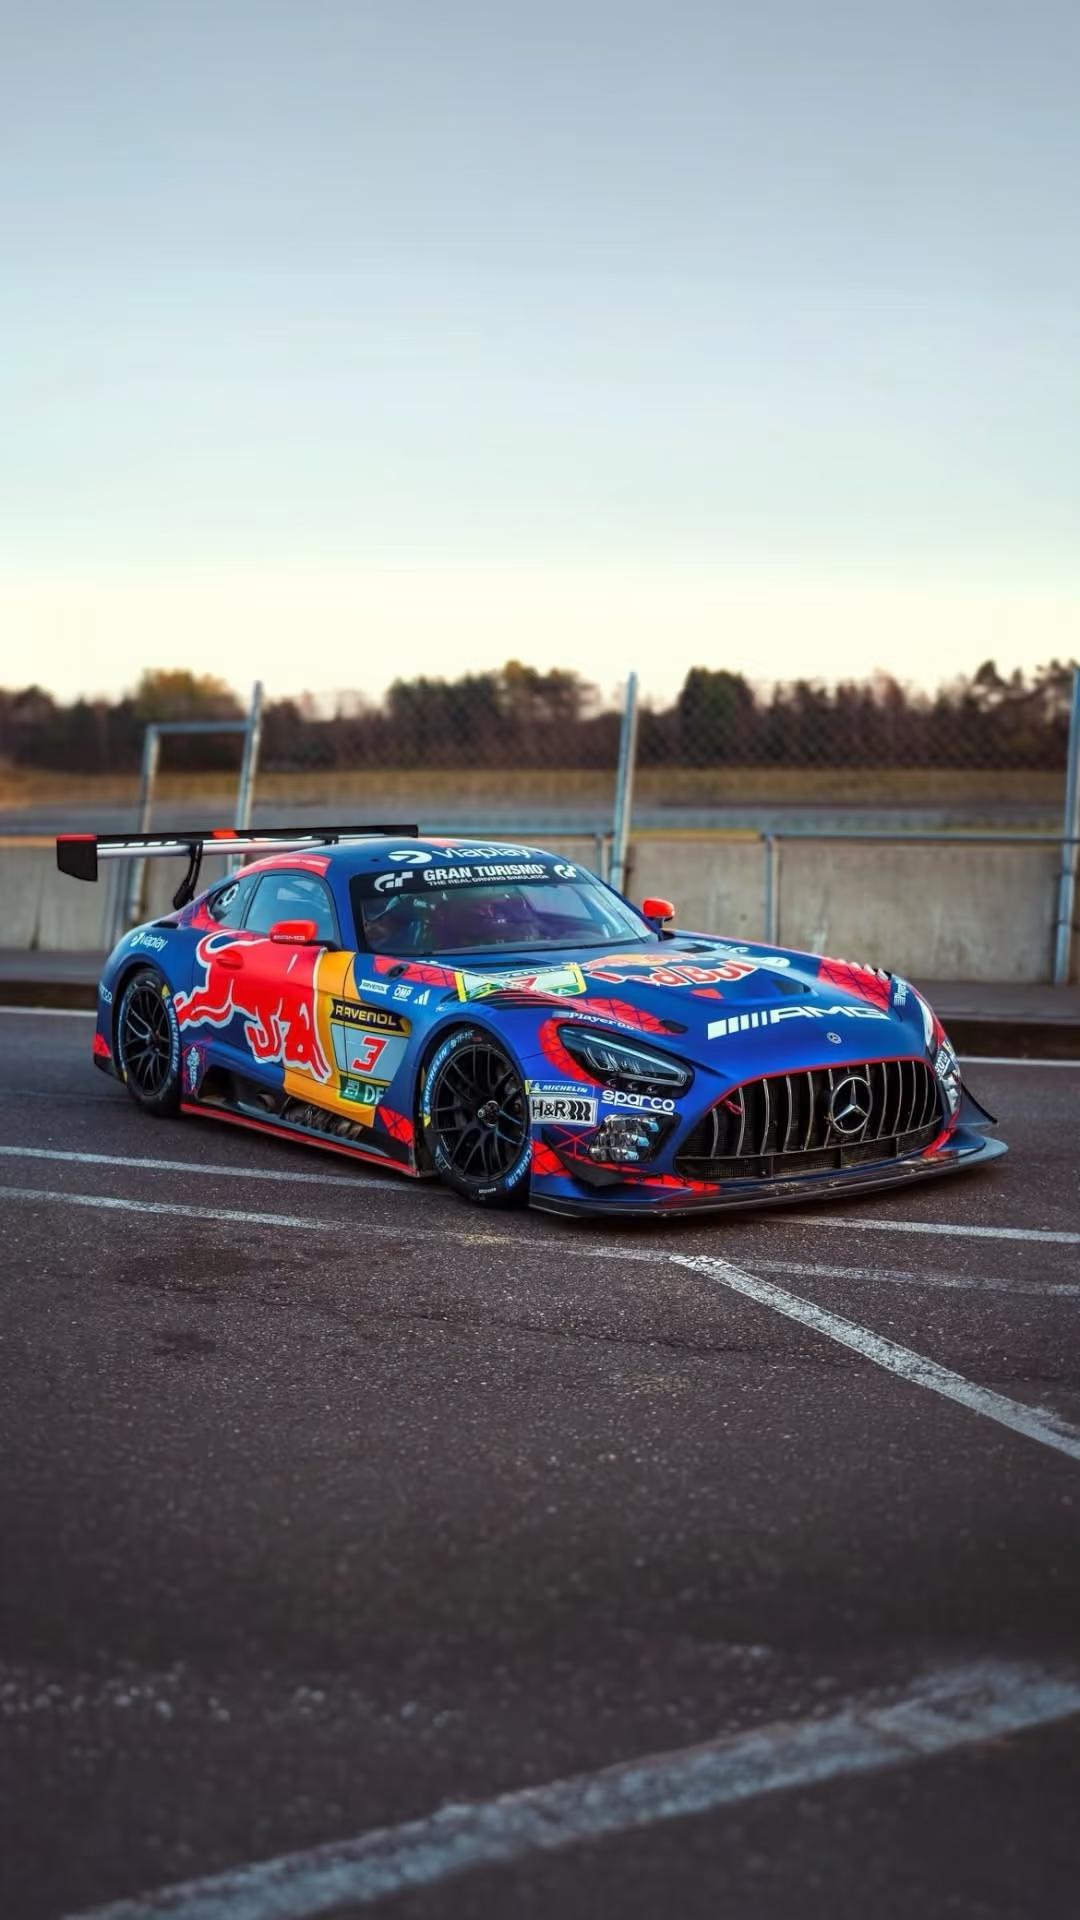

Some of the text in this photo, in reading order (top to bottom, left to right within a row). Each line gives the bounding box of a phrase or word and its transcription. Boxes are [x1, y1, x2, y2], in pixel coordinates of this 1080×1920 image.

[423, 864, 543, 881] GRAN TURISMO
[335, 1004, 397, 1026] RAVENOL
[770, 1006, 891, 1024] AMG
[352, 1035, 389, 1074] 3
[424, 1048, 448, 1103] MICHELIN
[542, 1084, 588, 1093] MICHELIN
[532, 1101, 567, 1118] H&R
[602, 1089, 675, 1112] sparco
